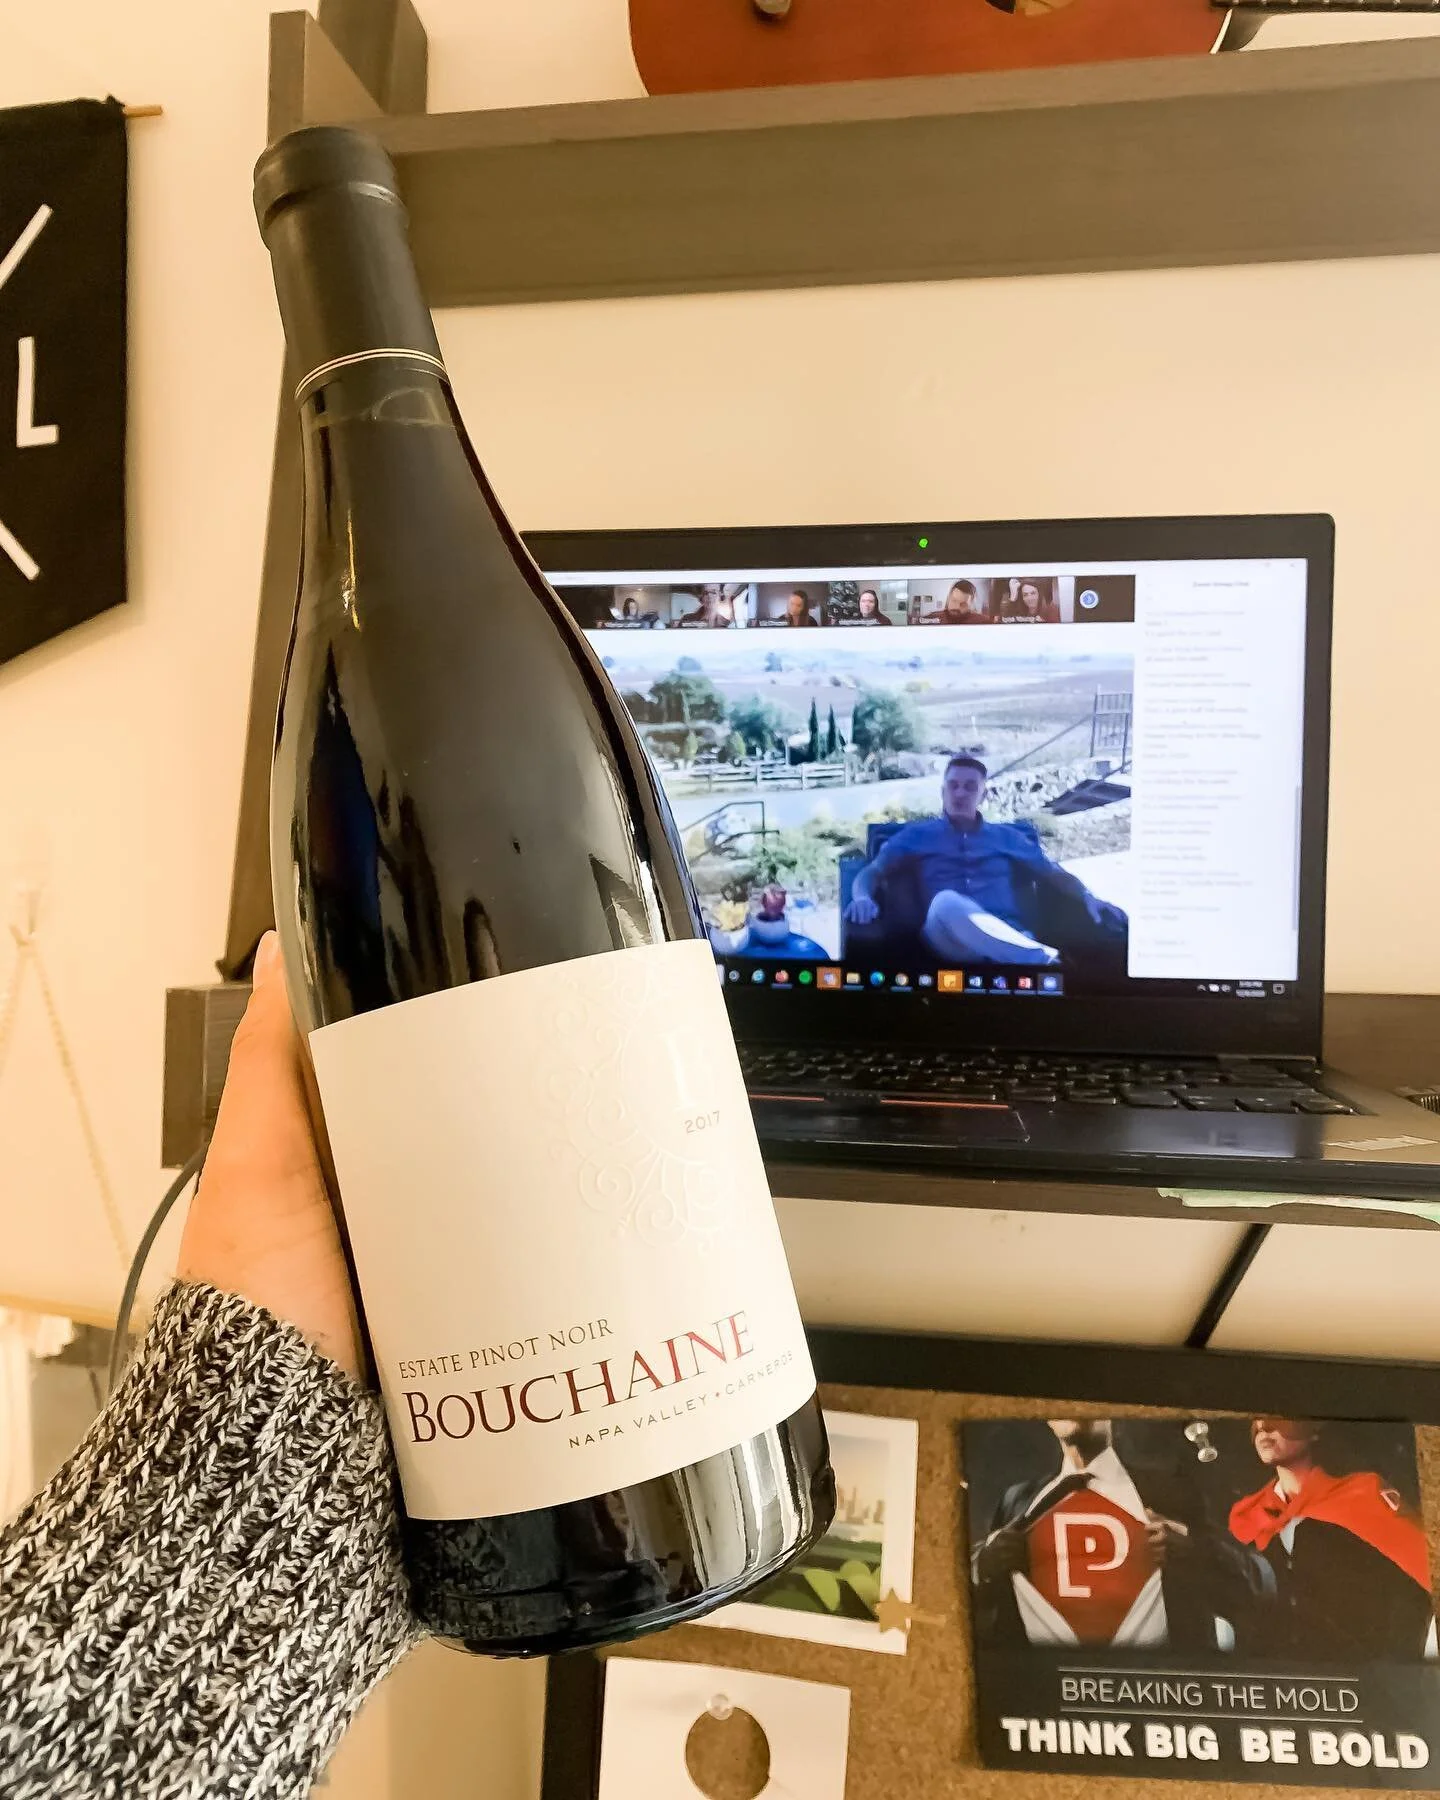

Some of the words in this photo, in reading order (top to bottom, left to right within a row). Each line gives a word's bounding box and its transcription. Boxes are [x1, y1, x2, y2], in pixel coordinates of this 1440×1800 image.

[685, 1110, 722, 1134] 2017
[399, 1354, 464, 1380] ESTATE
[469, 1336, 539, 1370] PINOT
[550, 1317, 614, 1349] NOIR
[402, 1309, 755, 1444] BOUCHAINE
[569, 1425, 624, 1449] NAPA
[632, 1394, 710, 1430] VALLEY
[724, 1348, 794, 1397] CARNEROS
[1061, 1676, 1203, 1707] BREAKING
[1211, 1684, 1266, 1709] THE
[1276, 1686, 1360, 1713] MOLD
[1000, 1717, 1134, 1757] THINK
[1144, 1724, 1219, 1761] BIG
[1239, 1727, 1299, 1764] BE
[1309, 1731, 1430, 1770] BOLD
